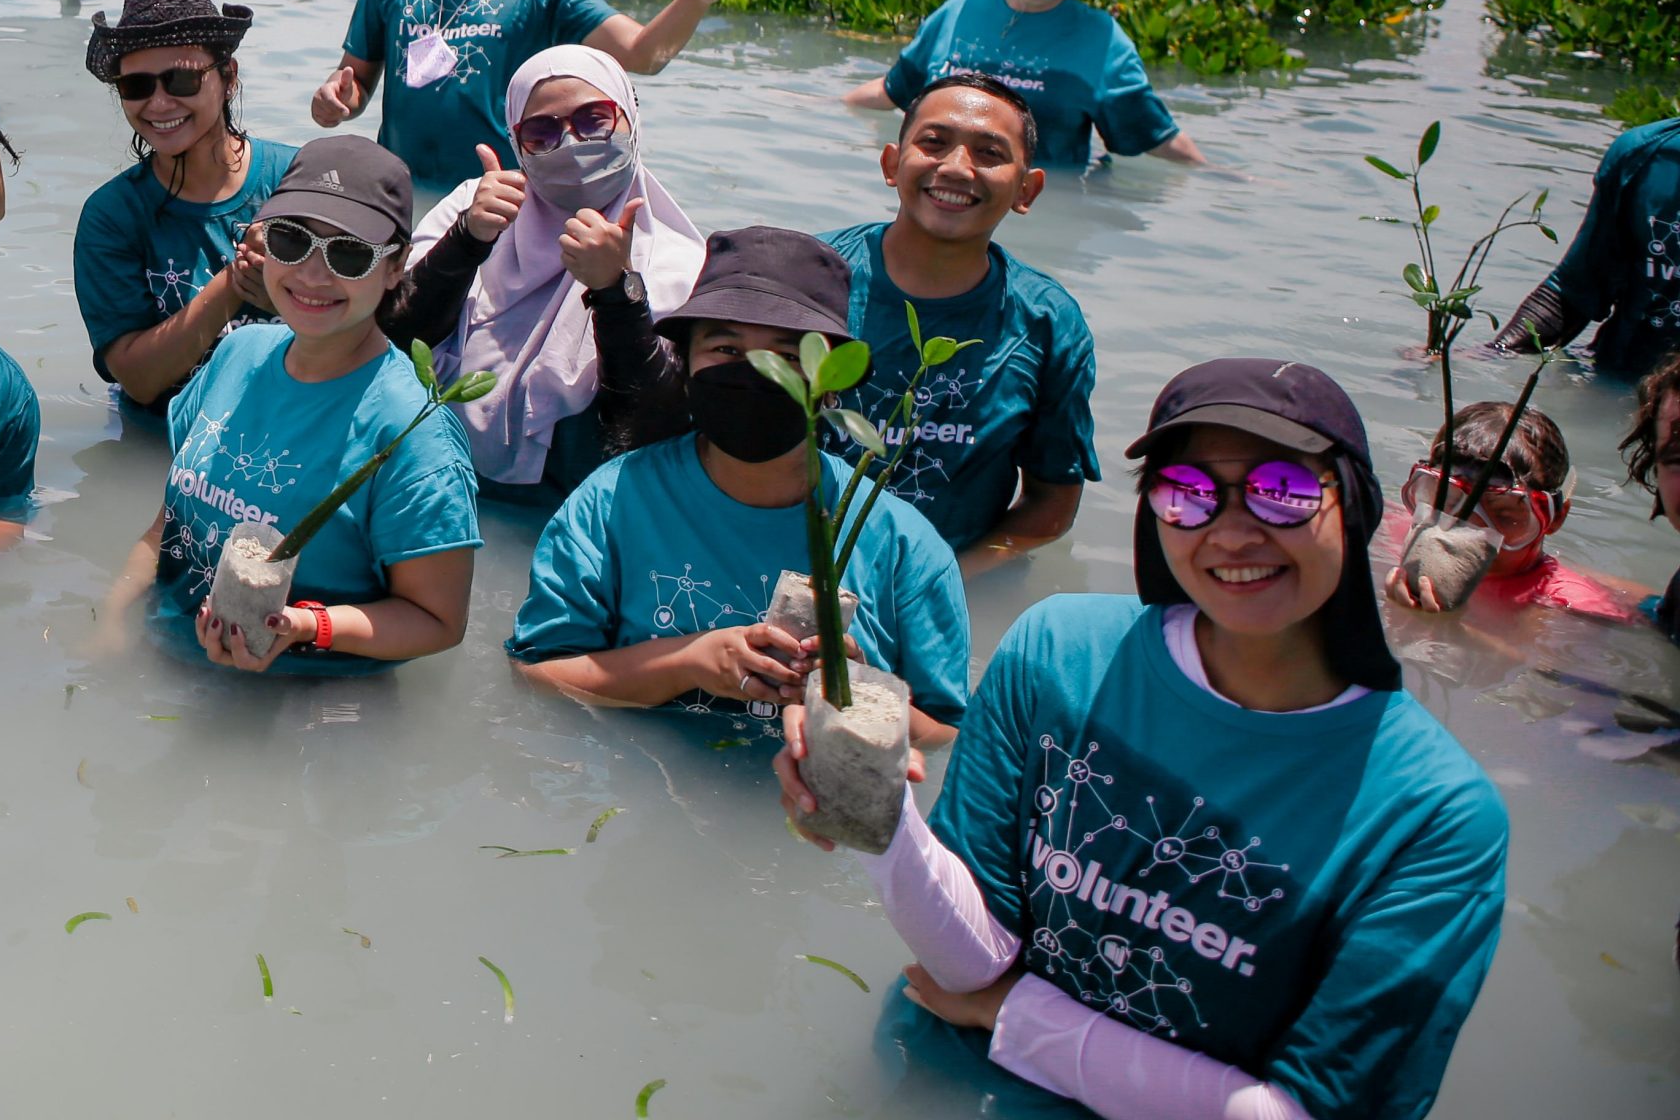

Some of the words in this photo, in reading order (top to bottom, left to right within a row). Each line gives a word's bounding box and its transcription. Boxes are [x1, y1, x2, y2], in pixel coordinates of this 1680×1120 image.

[399, 19, 405, 35] i
[1646, 257, 1655, 278] i
[1031, 833, 1258, 978] volunteer.
